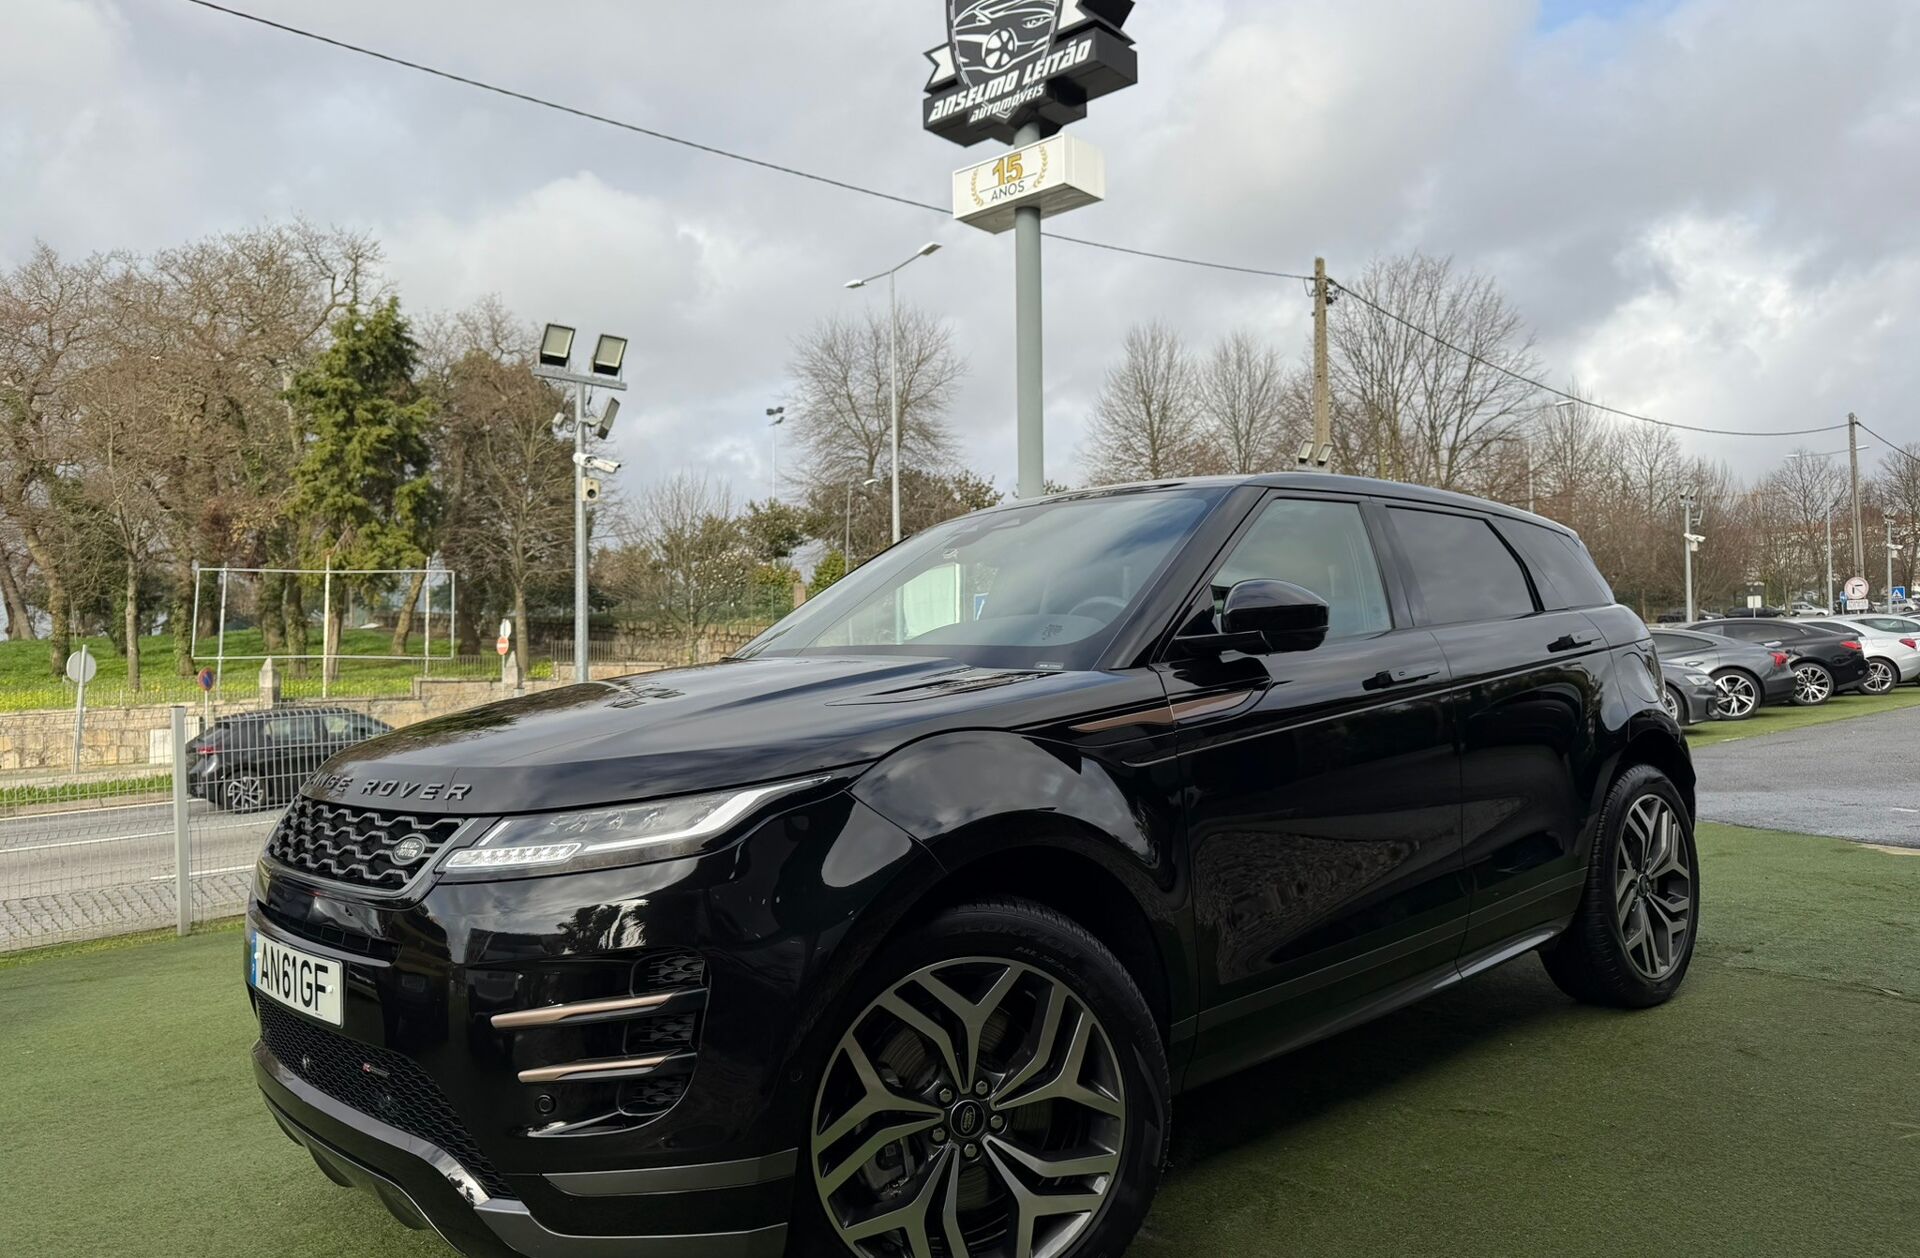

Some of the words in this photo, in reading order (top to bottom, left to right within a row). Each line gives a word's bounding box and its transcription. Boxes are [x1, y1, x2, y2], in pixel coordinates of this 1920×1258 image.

[1022, 38, 1093, 87] LEITÃO
[992, 152, 1024, 187] 15
[990, 180, 1025, 202] ANOS
[360, 779, 473, 801] ROVER
